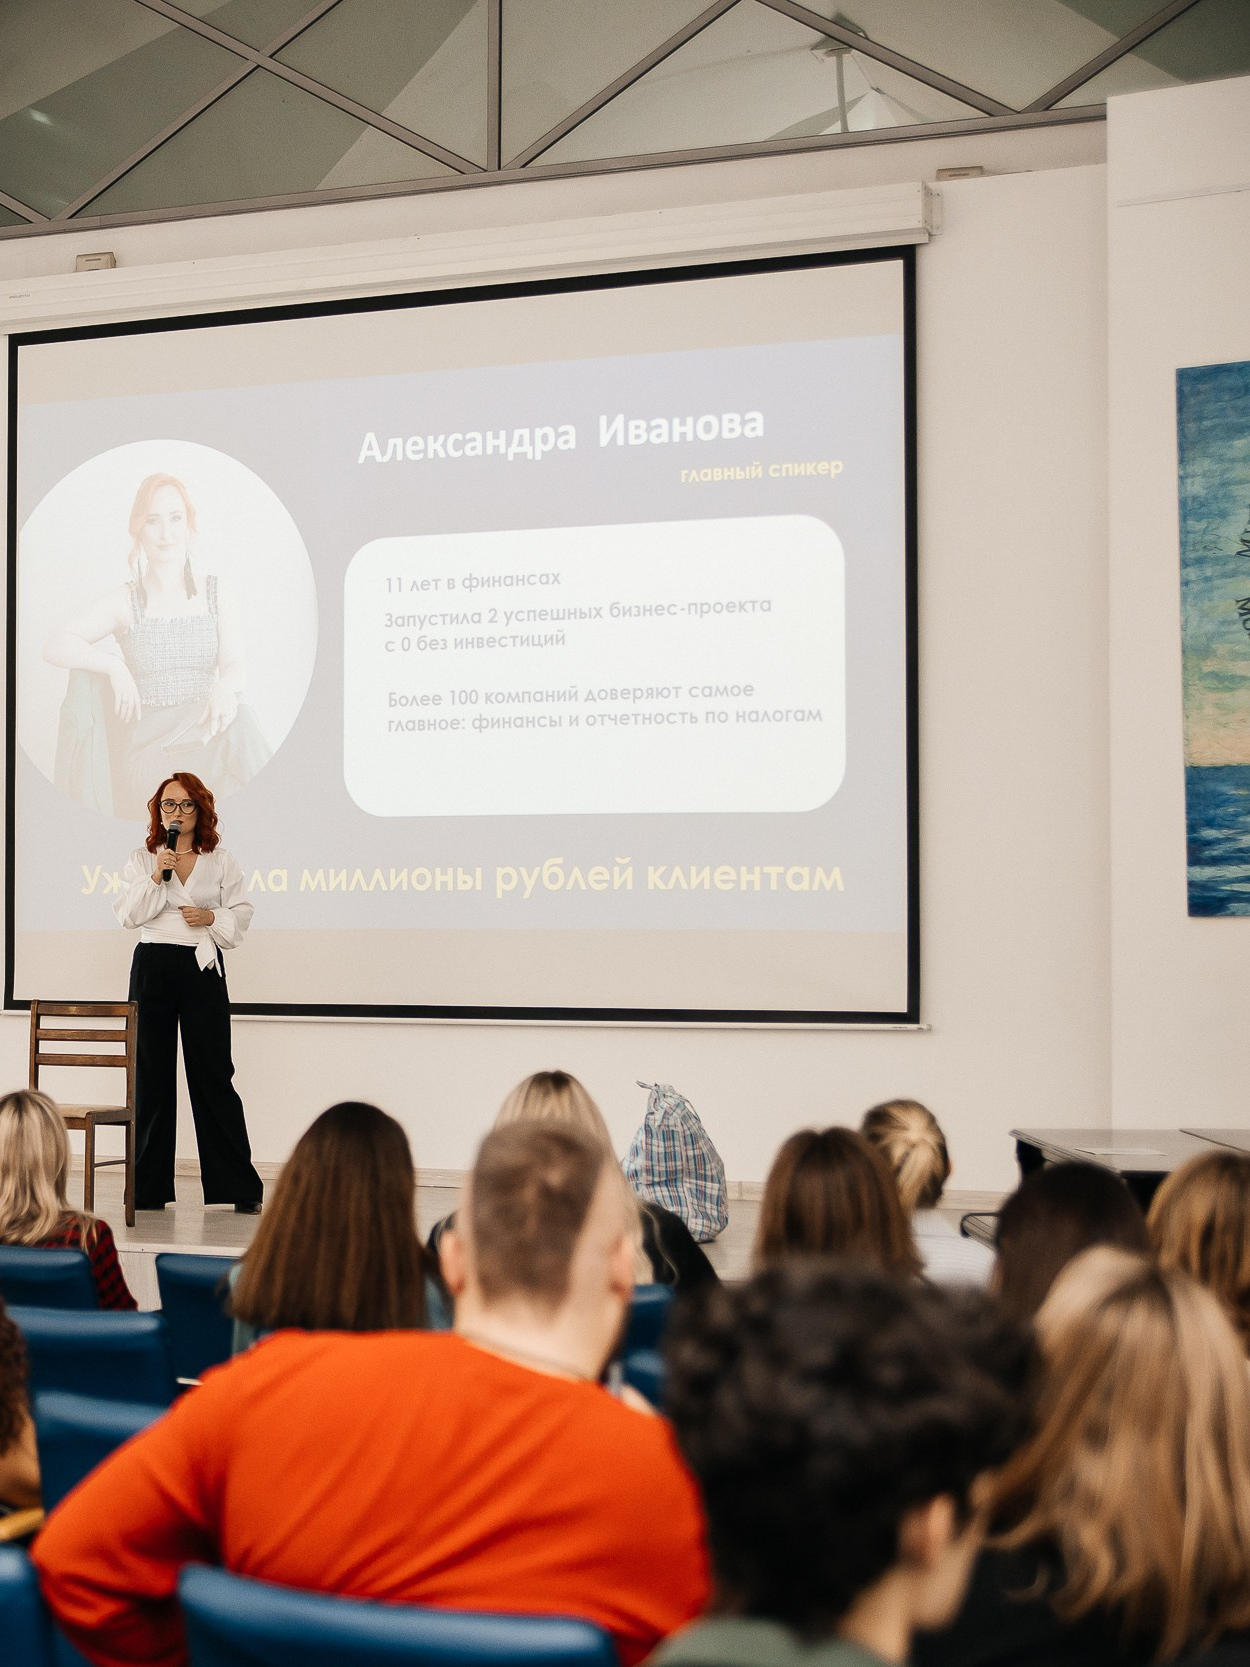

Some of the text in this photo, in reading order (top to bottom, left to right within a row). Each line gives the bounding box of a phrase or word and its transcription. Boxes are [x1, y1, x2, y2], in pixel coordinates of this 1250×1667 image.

[358, 411, 765, 463] Александра Иванова
[680, 459, 844, 484] главный спикер
[385, 573, 562, 593] 11 лет в финансах
[384, 599, 773, 631] Запустила 2 успешных бизнес-проекта
[384, 630, 567, 653] с 0 без инвестиций
[388, 684, 756, 708] Более 100 компаний доверяют самое
[388, 709, 824, 734] главное: финансы и отчетность по налогам
[81, 864, 122, 895] Уж
[299, 867, 484, 893] миллионы
[495, 857, 634, 899] рублей
[647, 865, 846, 892] клиентам
